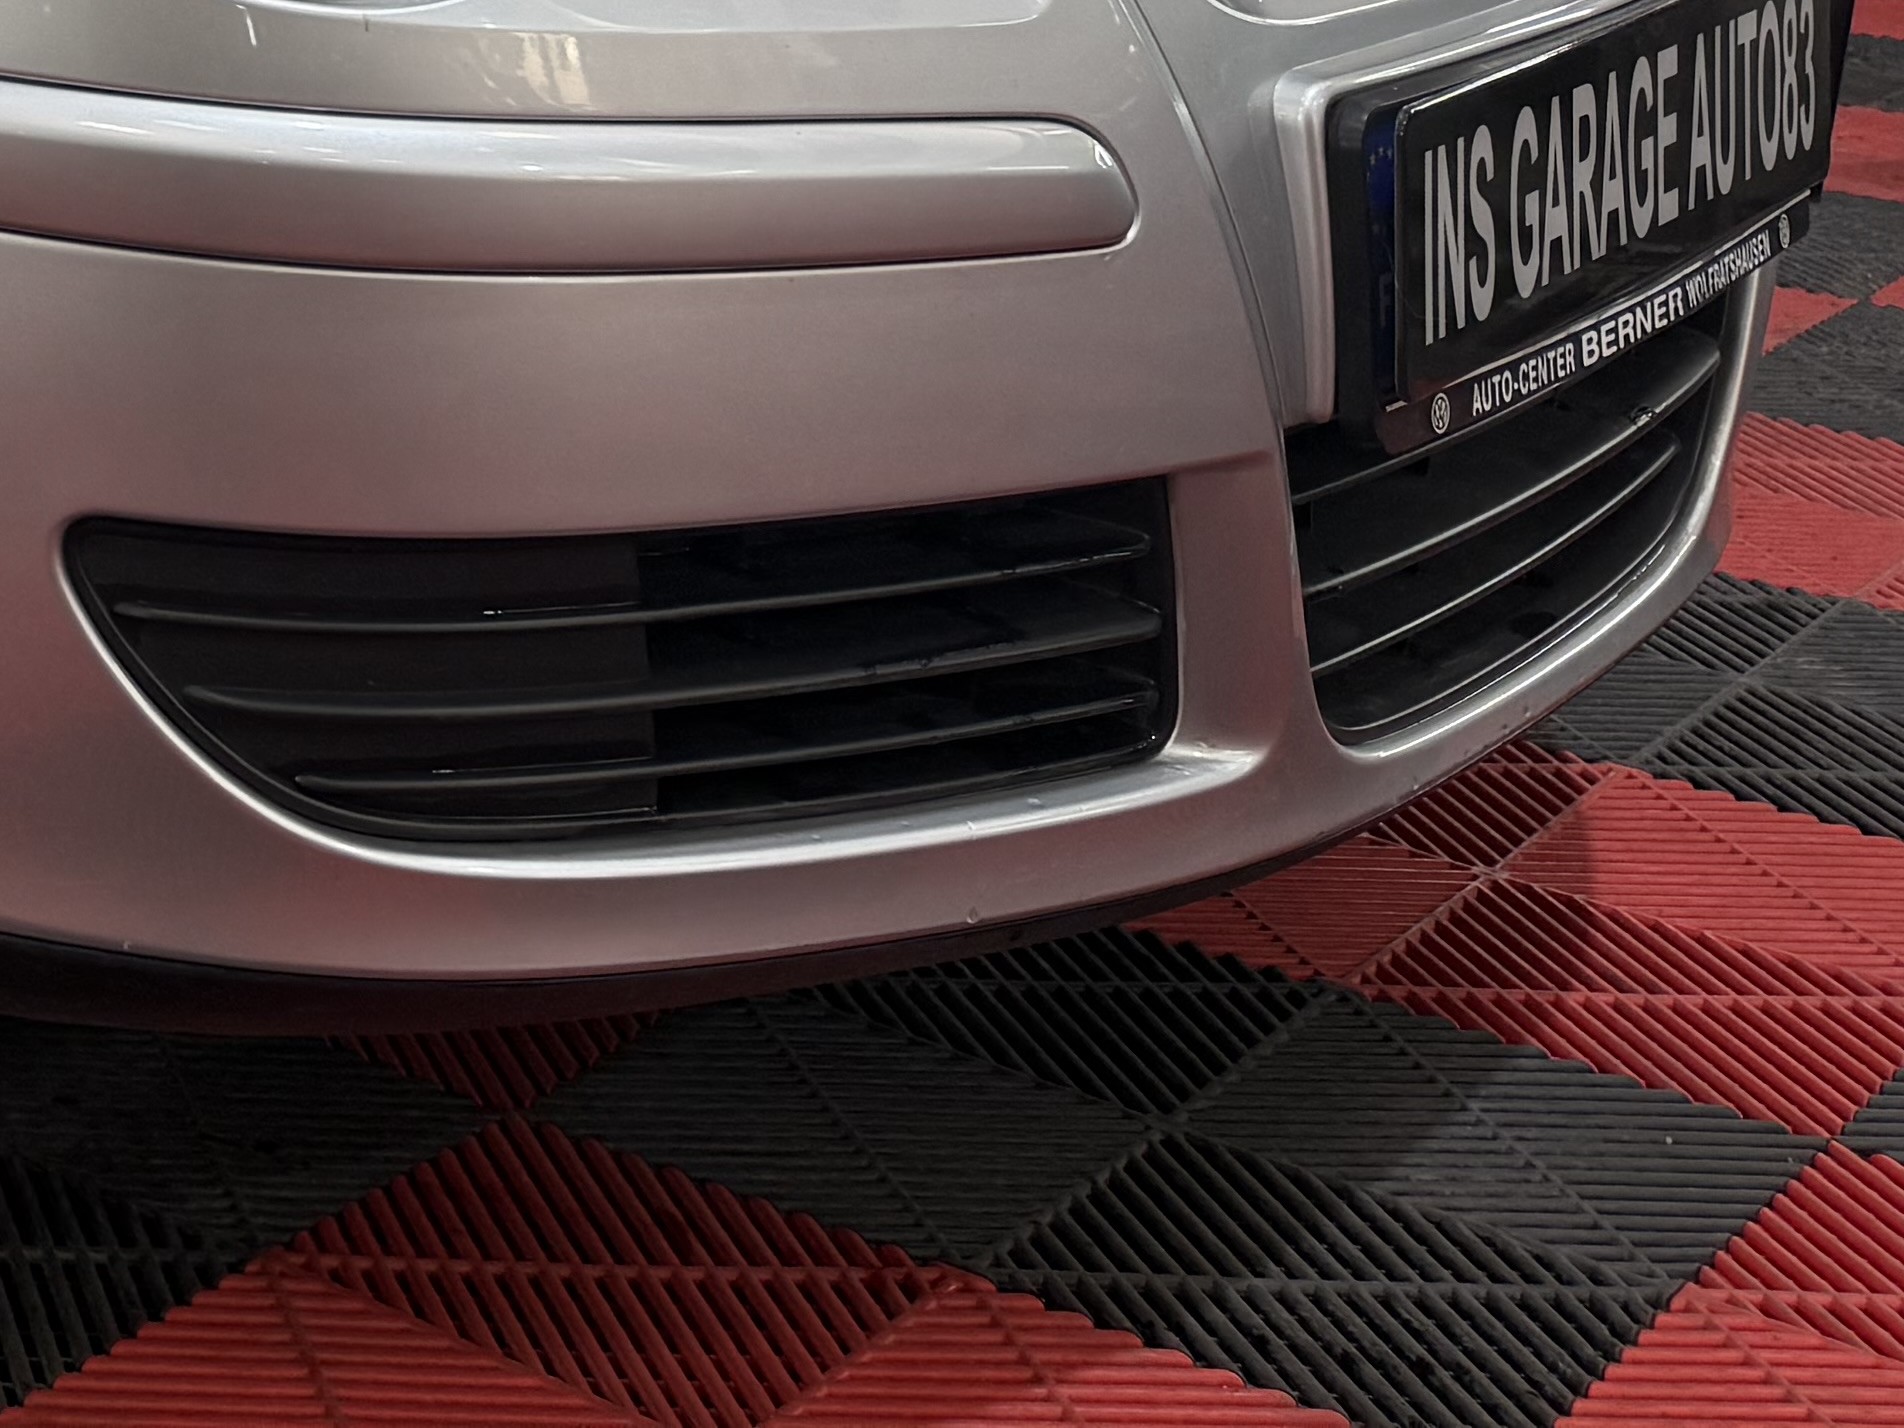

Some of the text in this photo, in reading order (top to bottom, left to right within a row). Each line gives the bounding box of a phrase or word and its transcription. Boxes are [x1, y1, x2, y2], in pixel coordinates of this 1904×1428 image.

[1425, 125, 1495, 345] INS
[1510, 45, 1679, 299] GARAGE
[1472, 342, 1576, 417] AUTO-CENTER
[1581, 286, 1685, 367] BERNER
[1685, 229, 1772, 309] WOLFRATSHAUSEN
